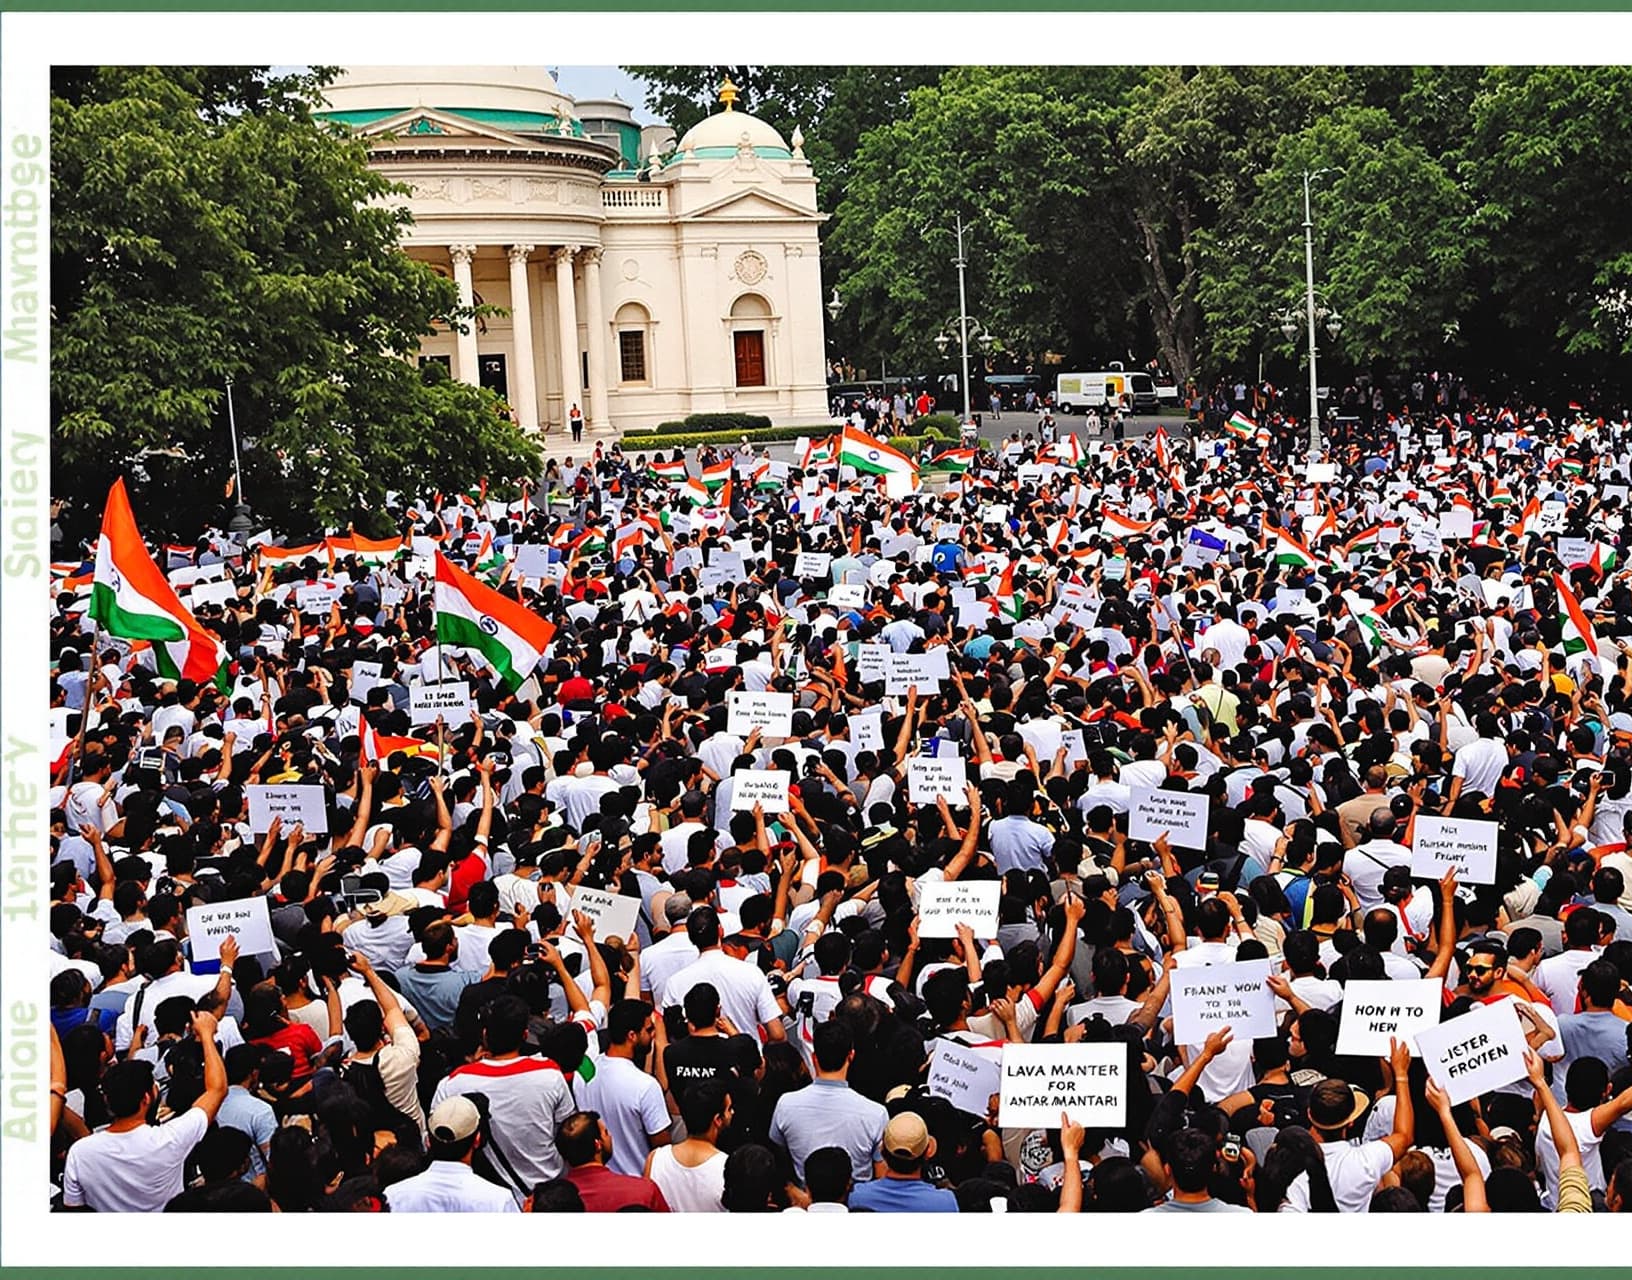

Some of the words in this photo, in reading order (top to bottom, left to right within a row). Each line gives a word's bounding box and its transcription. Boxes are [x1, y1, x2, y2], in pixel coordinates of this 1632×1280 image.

[1354, 1004, 1386, 1017] HON
[1405, 1006, 1424, 1018] TO
[1007, 1065, 1046, 1077] LAVA
[1051, 1064, 1119, 1077] MANTER
[1047, 1080, 1076, 1092] FOR
